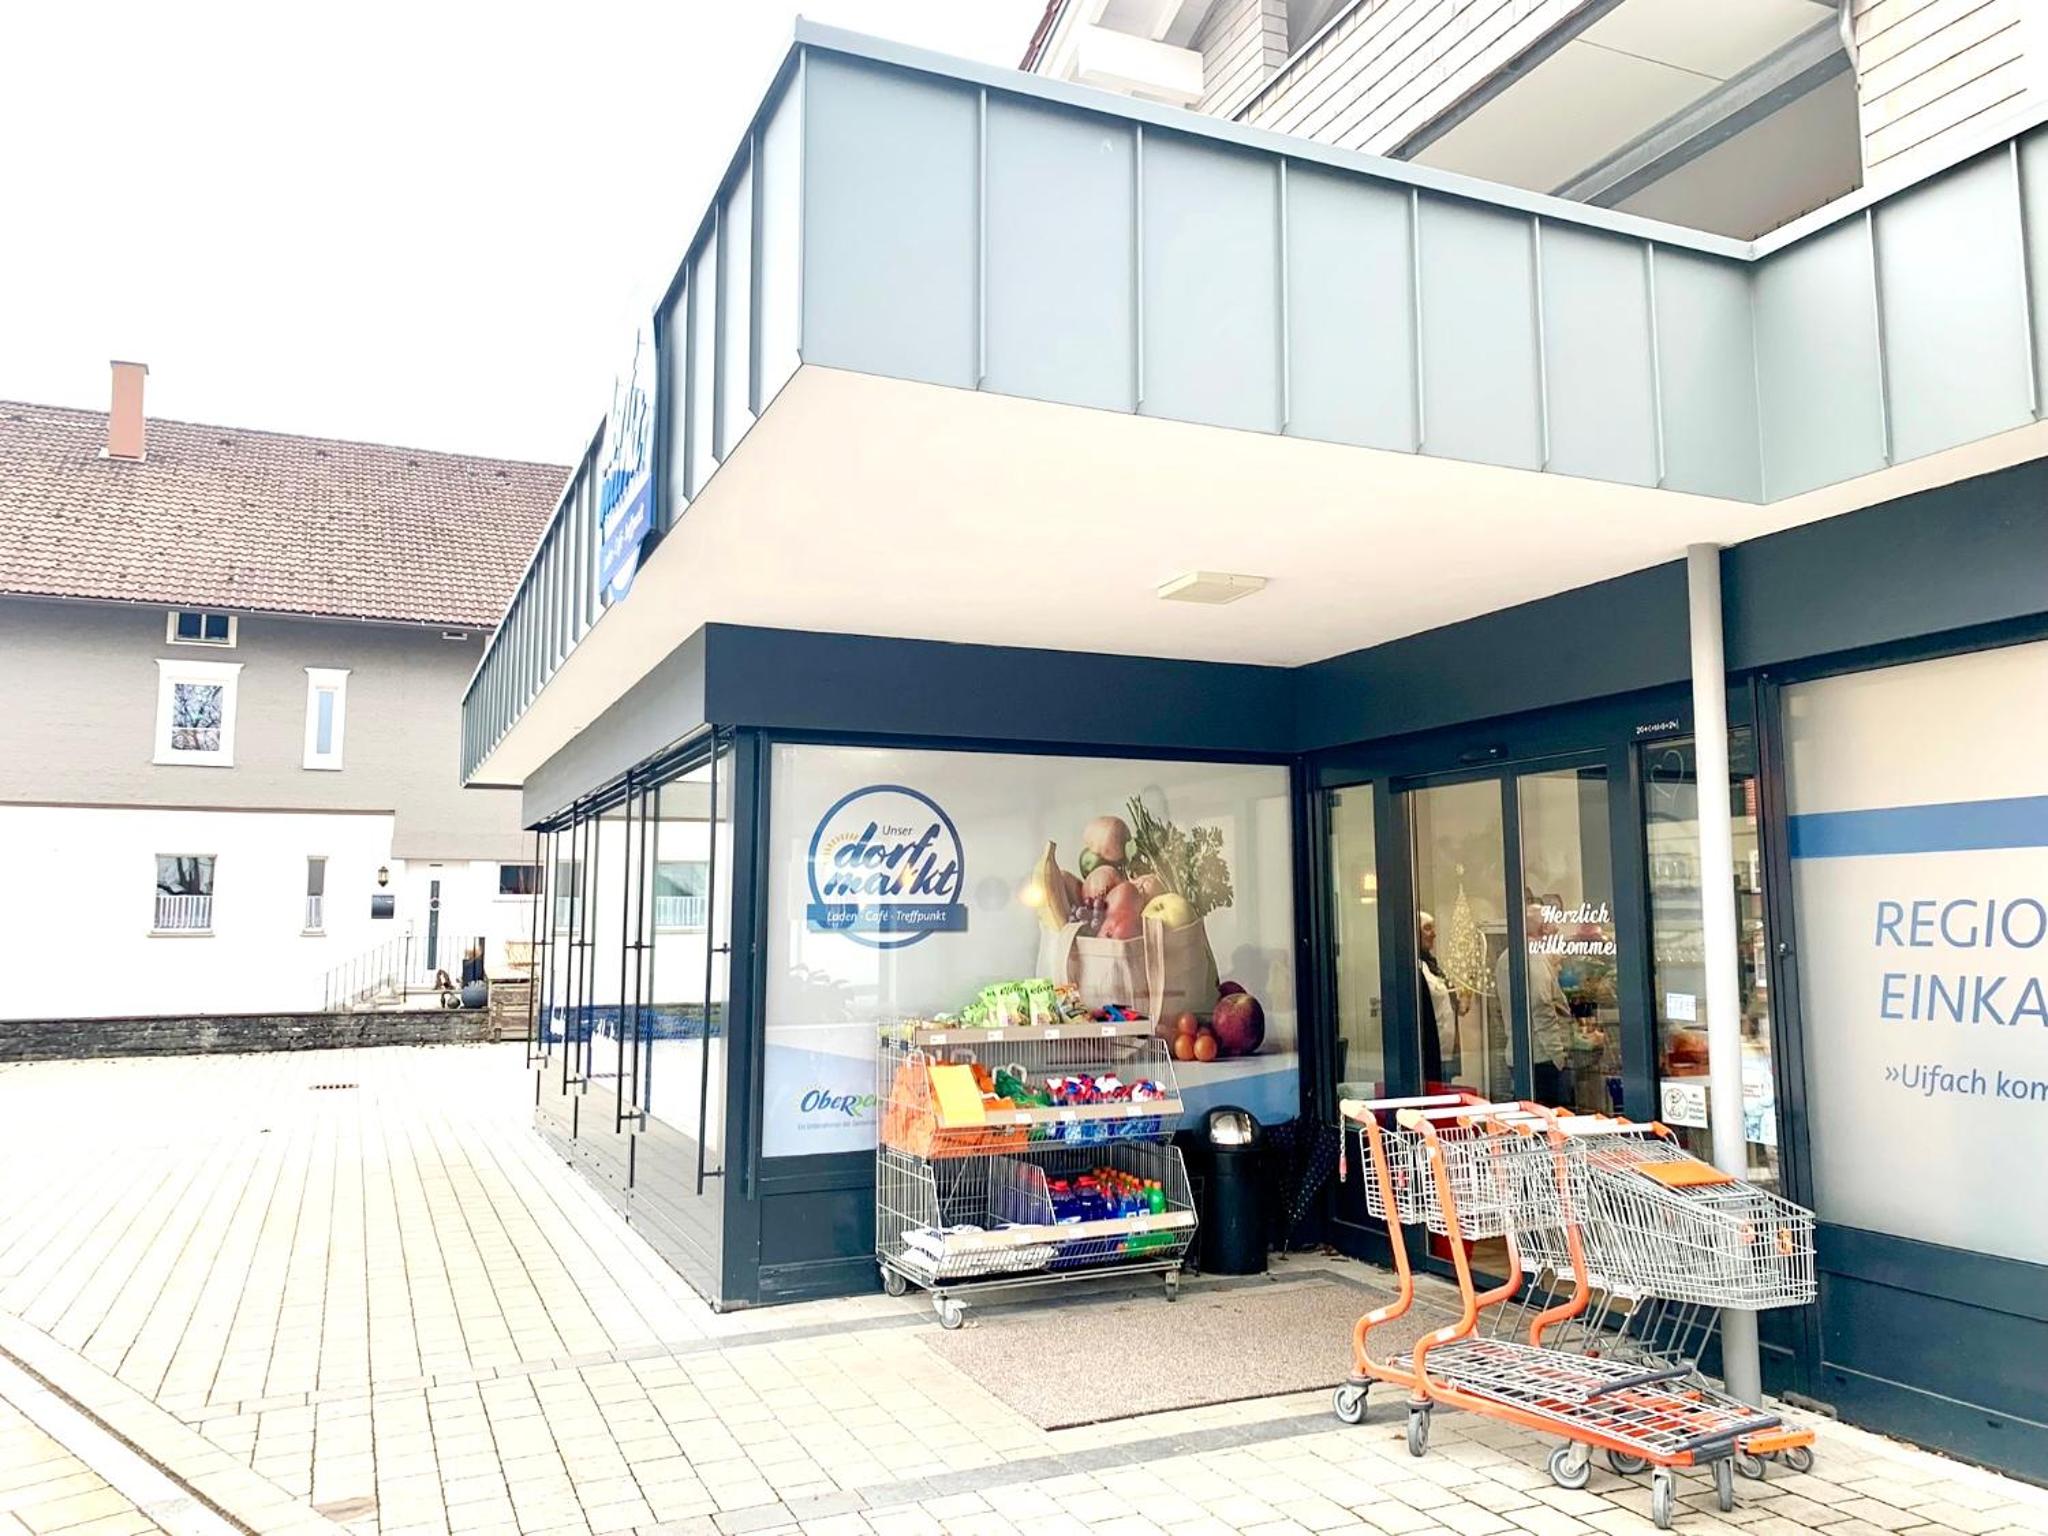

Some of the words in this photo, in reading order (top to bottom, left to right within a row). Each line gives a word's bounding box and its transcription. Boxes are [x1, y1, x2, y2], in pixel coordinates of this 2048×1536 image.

[834, 821, 941, 869] dorf
[882, 825, 913, 836] Unser
[823, 852, 960, 897] markt
[827, 911, 857, 921] Laden
[865, 910, 888, 922] Café
[896, 910, 946, 923] Treffpunkt
[1541, 902, 1610, 923] Herzlich
[1875, 898, 2048, 949] REGIO
[1881, 972, 2048, 1028] EINKA
